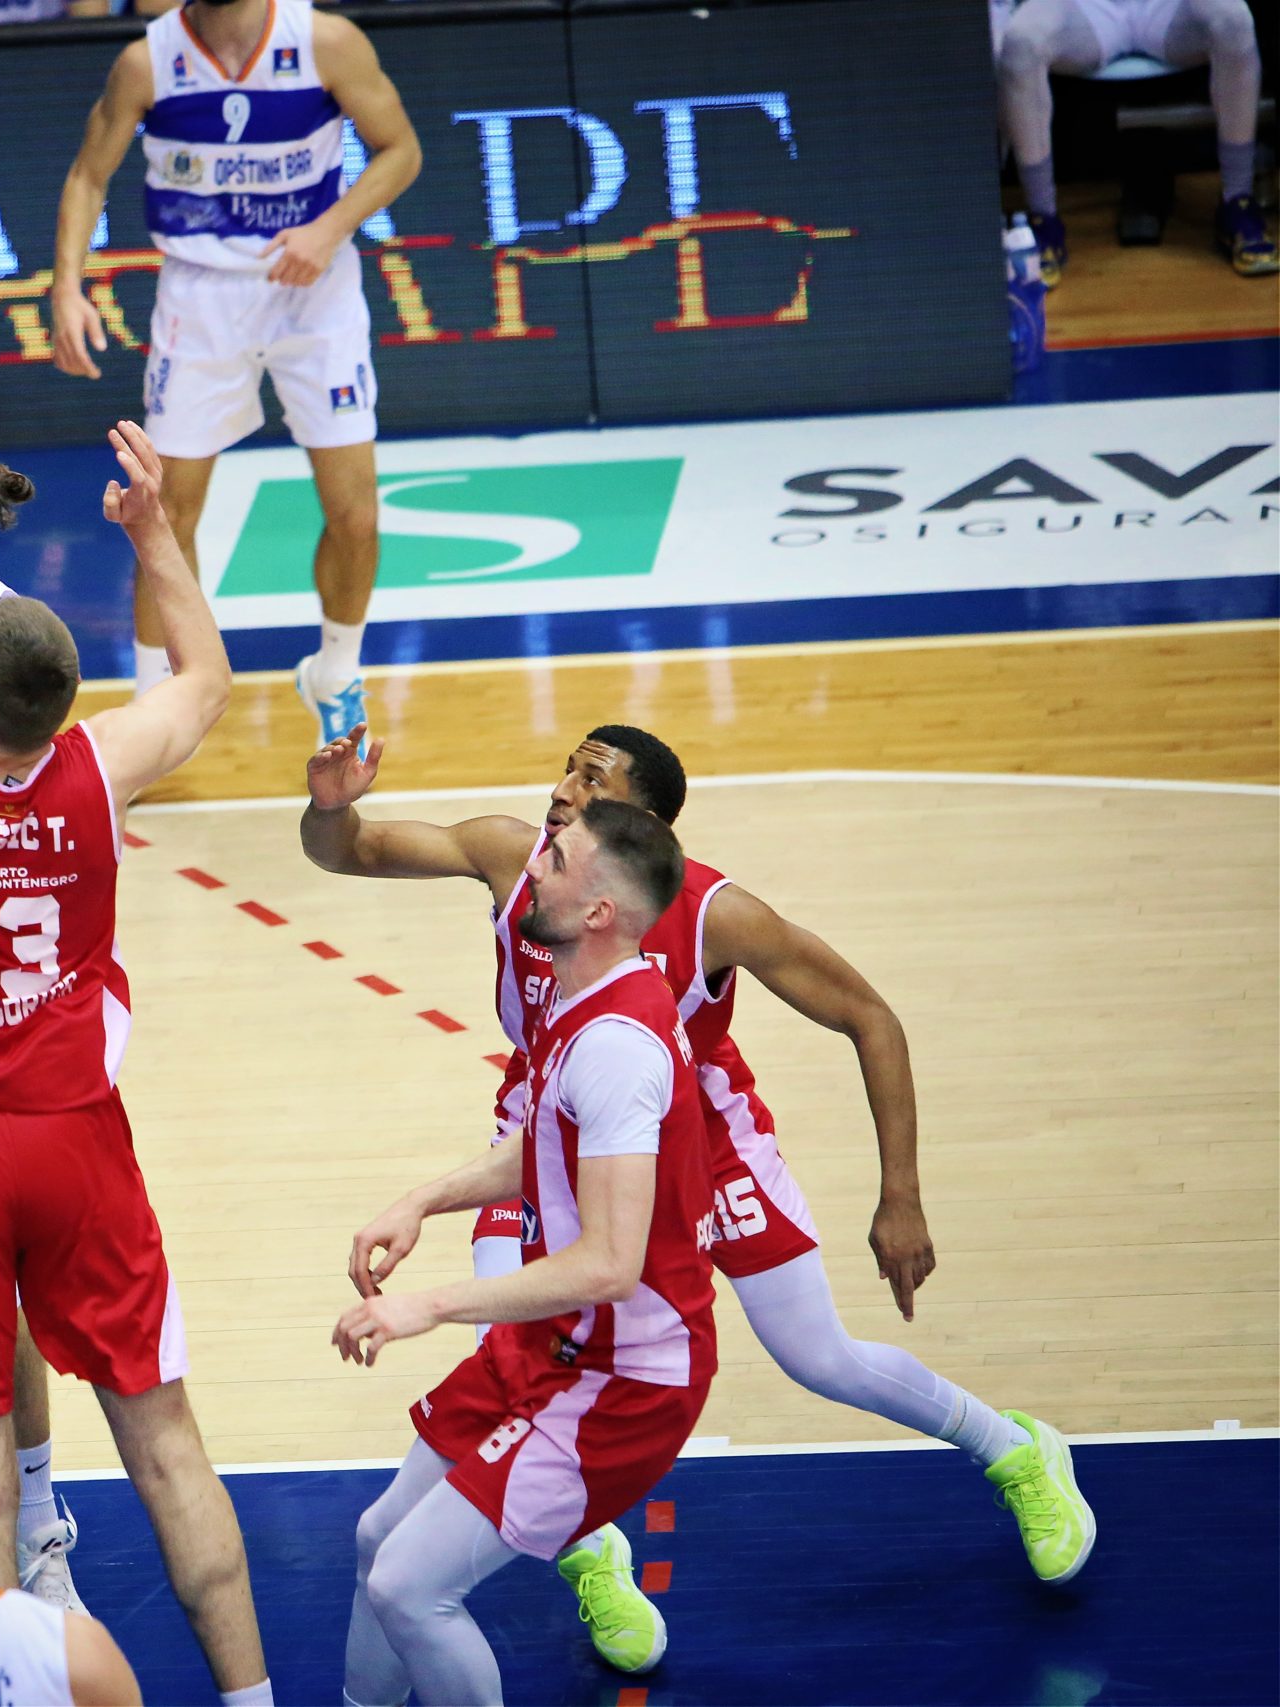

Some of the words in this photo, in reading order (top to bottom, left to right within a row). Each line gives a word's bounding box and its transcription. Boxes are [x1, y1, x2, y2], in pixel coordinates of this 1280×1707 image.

[222, 93, 251, 144] 9
[777, 443, 1280, 519] SAV
[46, 816, 75, 853] T.
[519, 939, 554, 963] SPALD
[477, 1416, 531, 1464] 8
